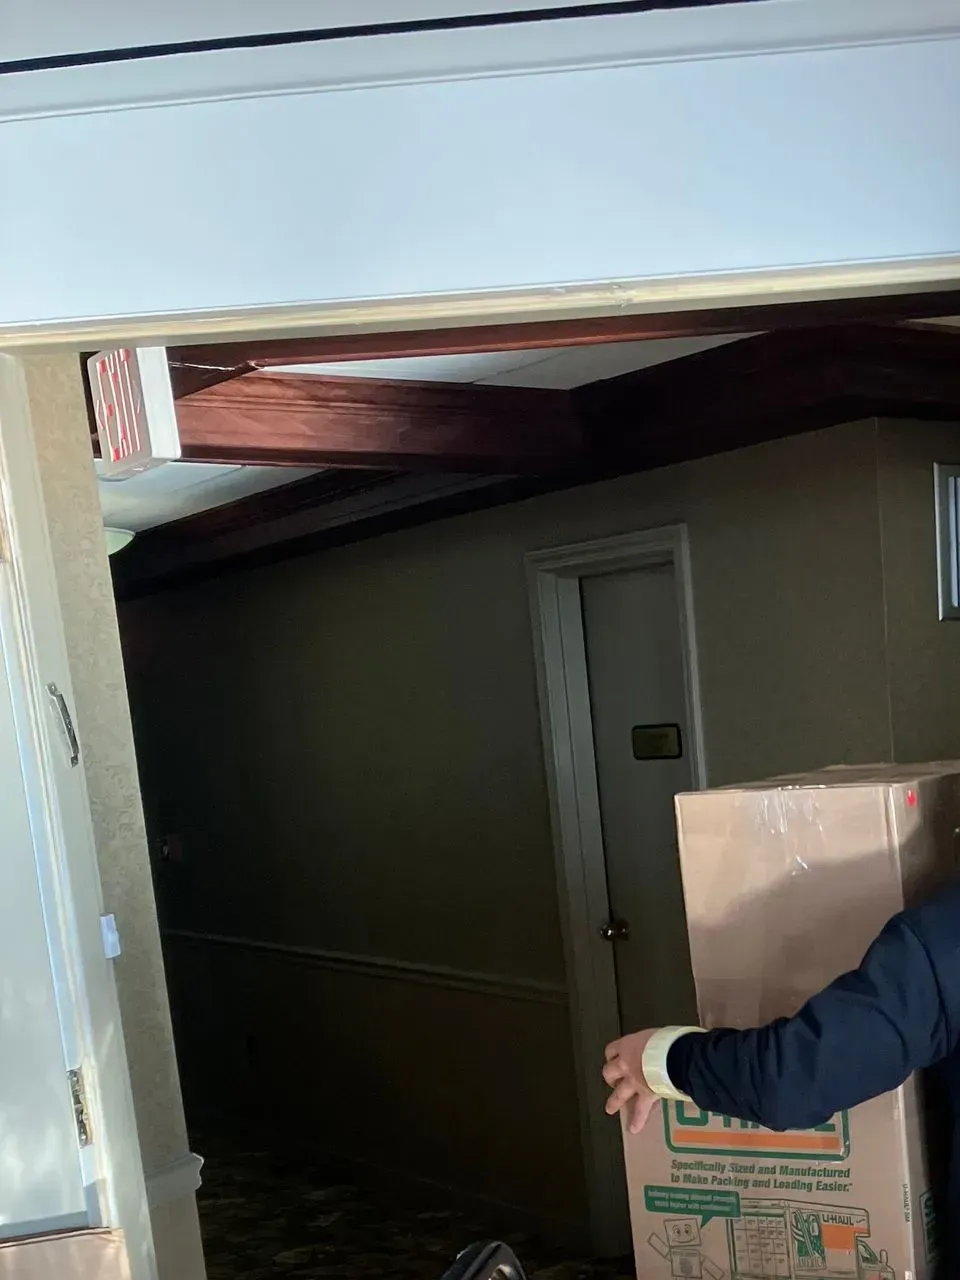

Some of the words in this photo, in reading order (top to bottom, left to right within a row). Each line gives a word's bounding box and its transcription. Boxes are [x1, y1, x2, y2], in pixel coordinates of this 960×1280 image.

[671, 1159, 726, 1173] Specifically
[728, 1163, 755, 1174] Sized
[757, 1164, 776, 1175] and
[779, 1165, 850, 1178] Manufactured
[671, 1173, 681, 1183] to
[683, 1173, 708, 1185] Make
[711, 1176, 749, 1188] Packing
[752, 1177, 771, 1189] and
[773, 1179, 812, 1192] Loading
